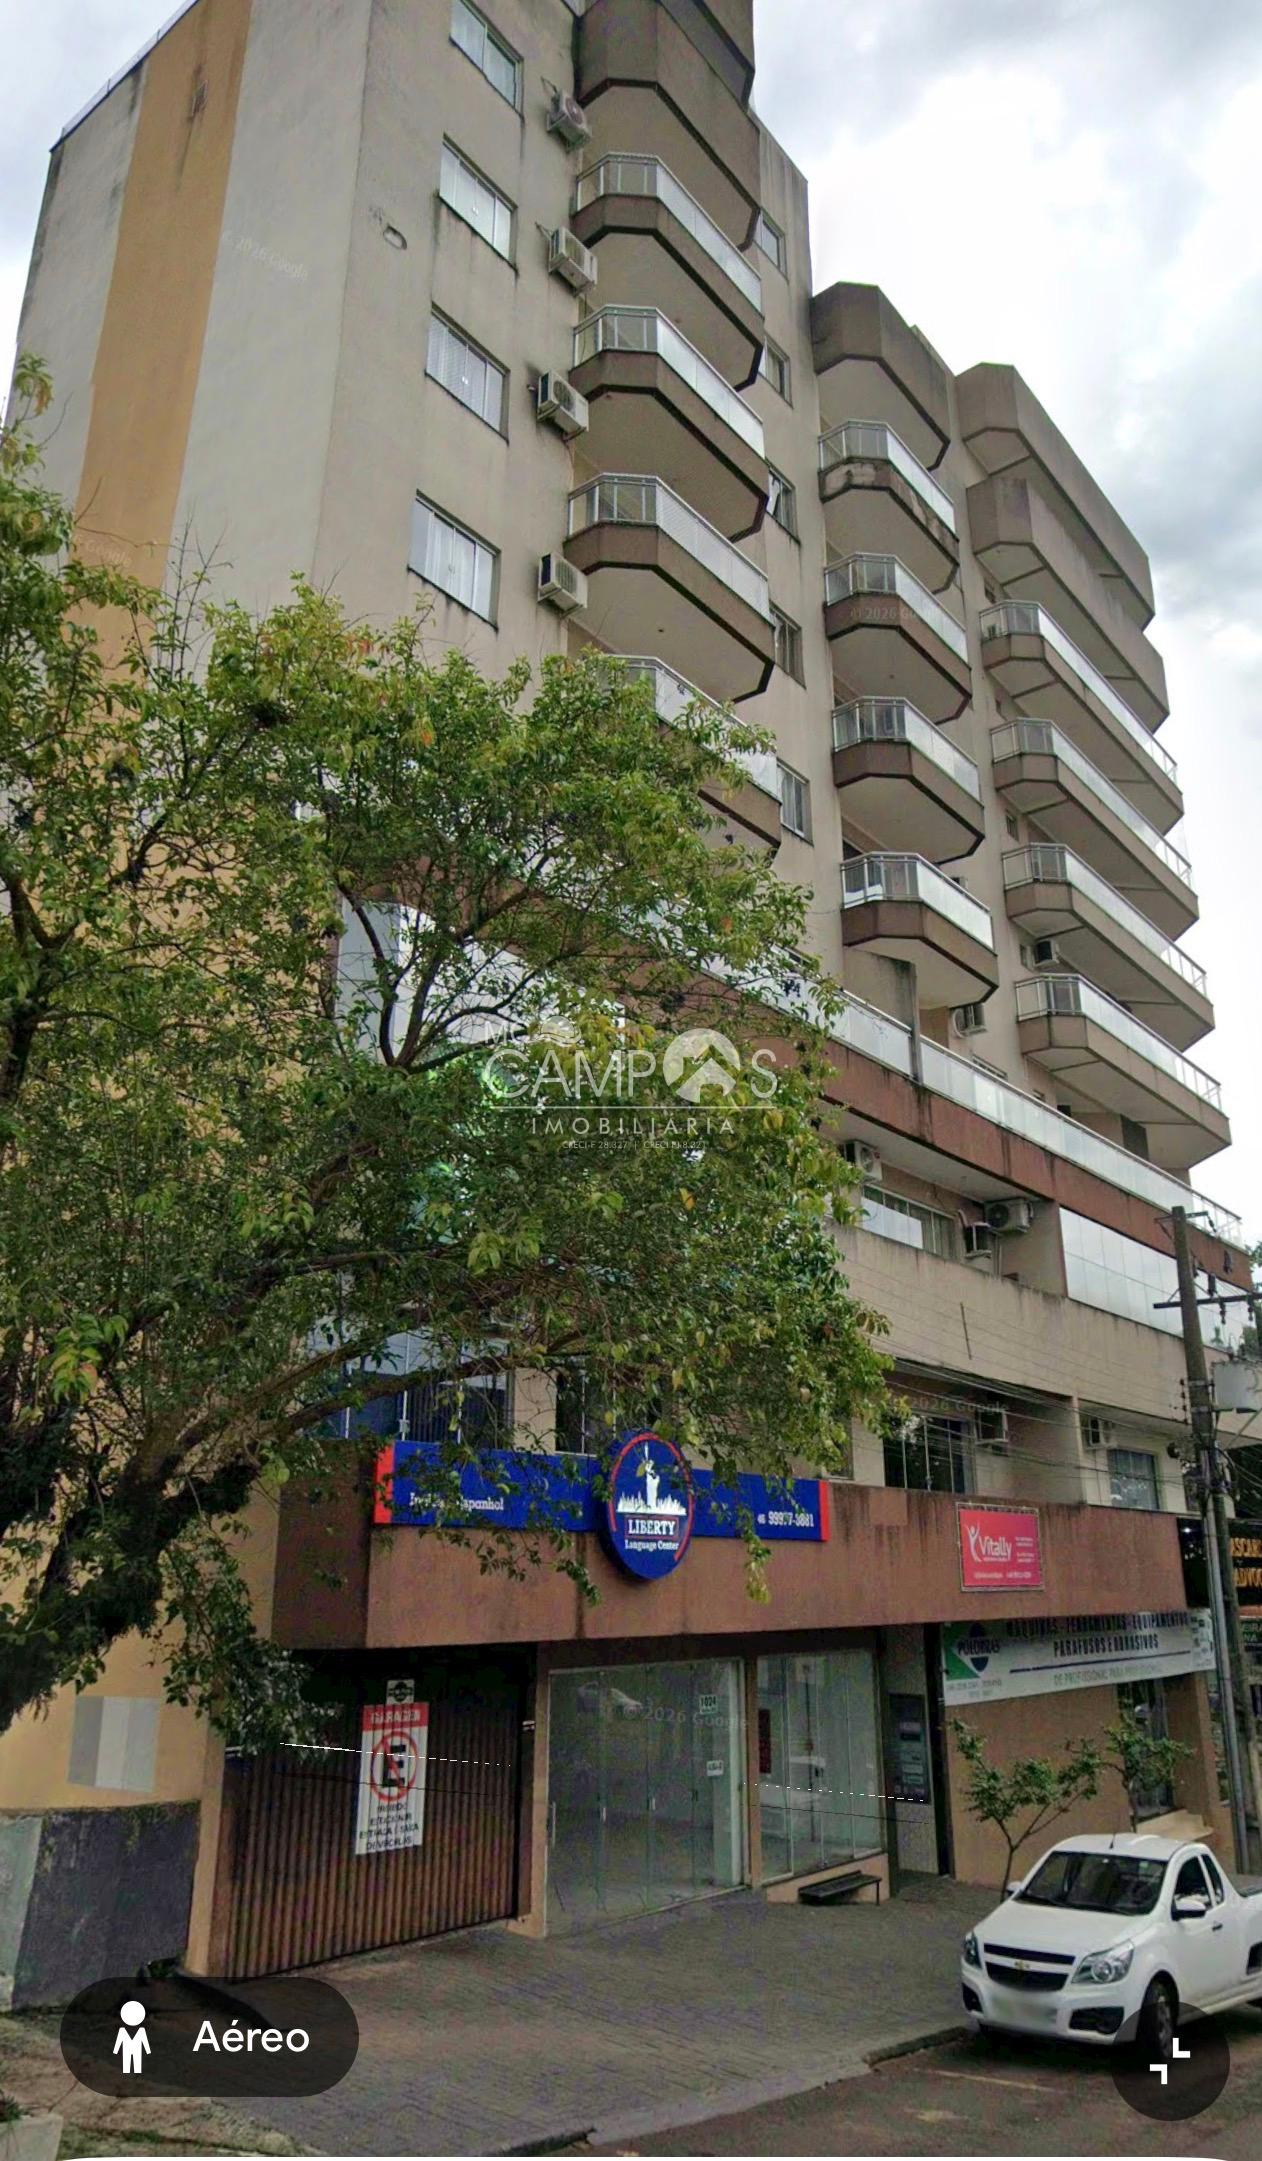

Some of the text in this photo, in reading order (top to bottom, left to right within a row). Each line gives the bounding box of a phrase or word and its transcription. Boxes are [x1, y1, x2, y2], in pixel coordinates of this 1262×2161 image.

[627, 1518, 676, 1536] LIBERTY
[625, 1539, 679, 1552] Language Center
[979, 1535, 1012, 1561] Vitally
